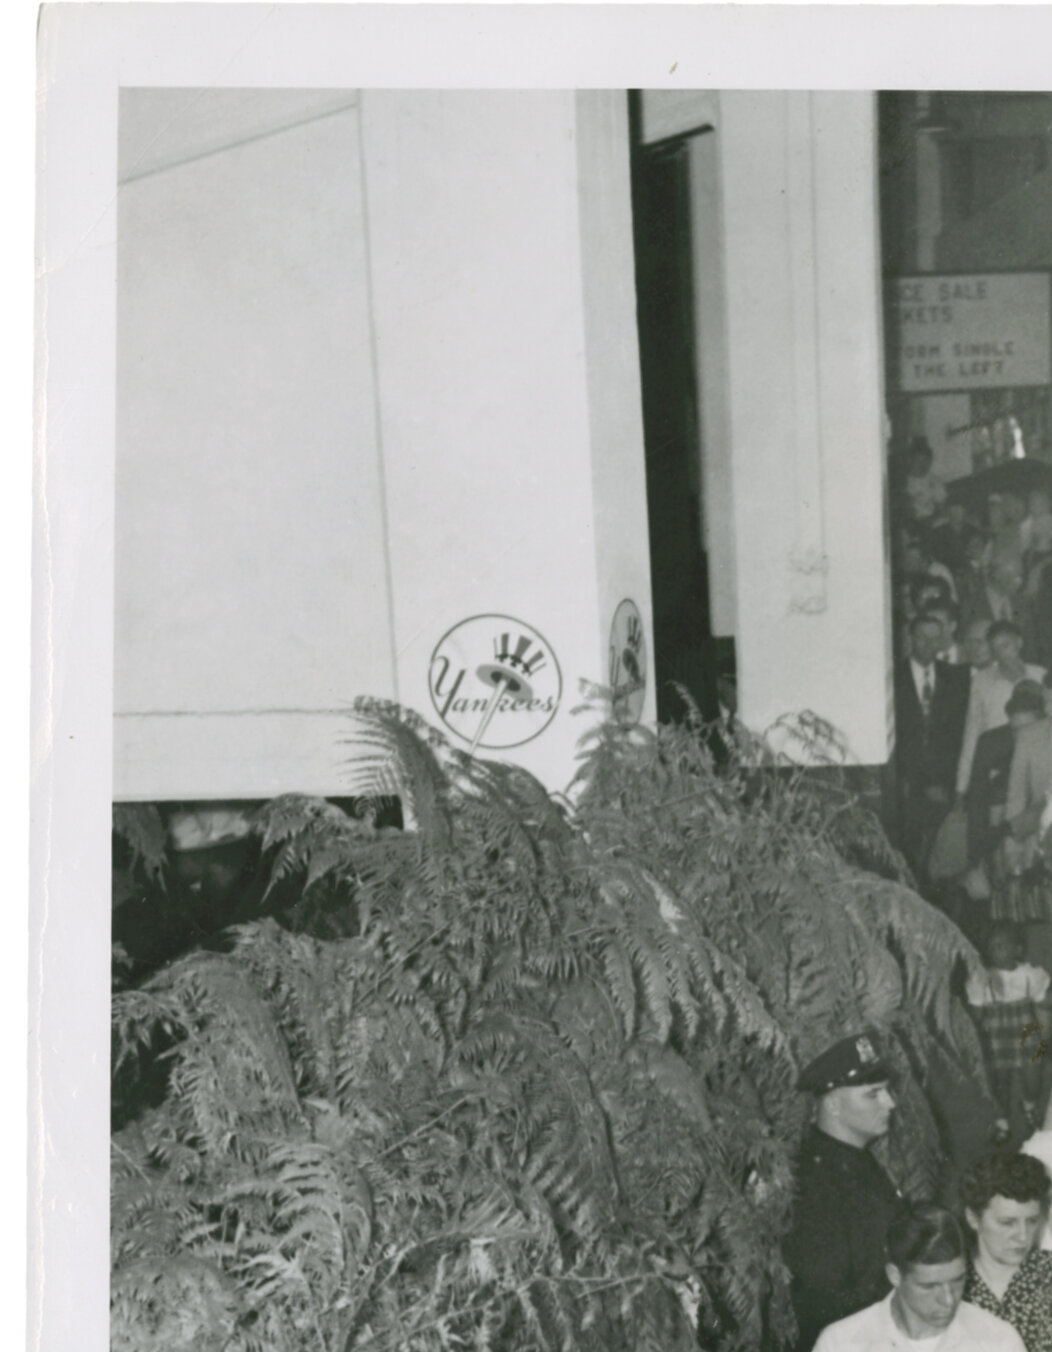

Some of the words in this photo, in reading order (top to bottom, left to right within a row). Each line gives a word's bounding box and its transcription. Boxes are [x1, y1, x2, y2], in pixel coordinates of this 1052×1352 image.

[938, 281, 987, 302] SALE
[903, 305, 953, 324] KETS
[953, 341, 1014, 357] SINGLE
[913, 363, 945, 379] THE
[959, 360, 1003, 376] LEFT
[434, 655, 554, 719] Yankees
